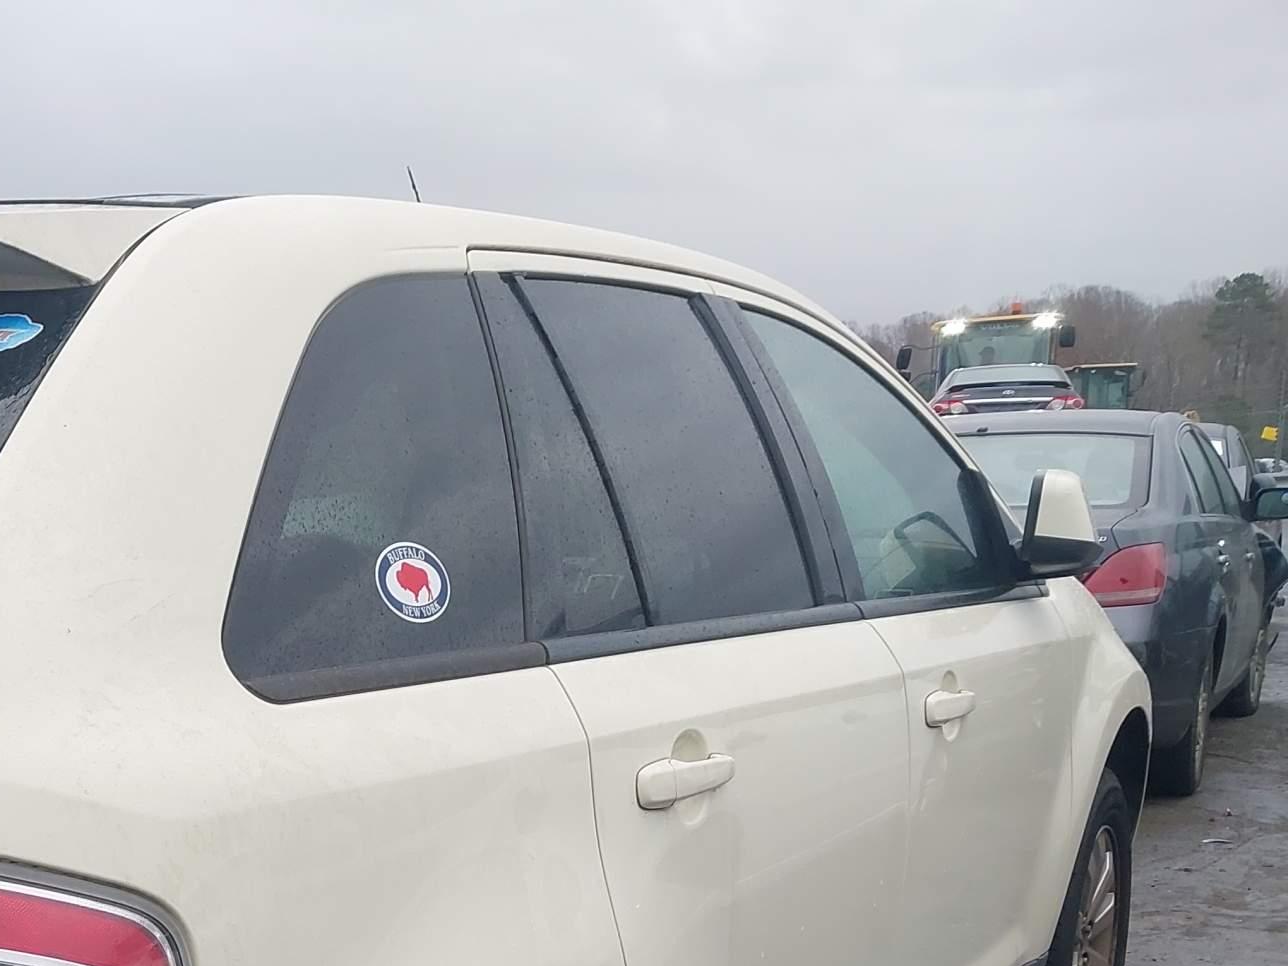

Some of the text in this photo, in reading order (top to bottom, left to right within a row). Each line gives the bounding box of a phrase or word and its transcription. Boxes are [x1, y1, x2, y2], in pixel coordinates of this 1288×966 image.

[387, 547, 425, 564] BUFFALO
[402, 601, 441, 618] NEW YORK
